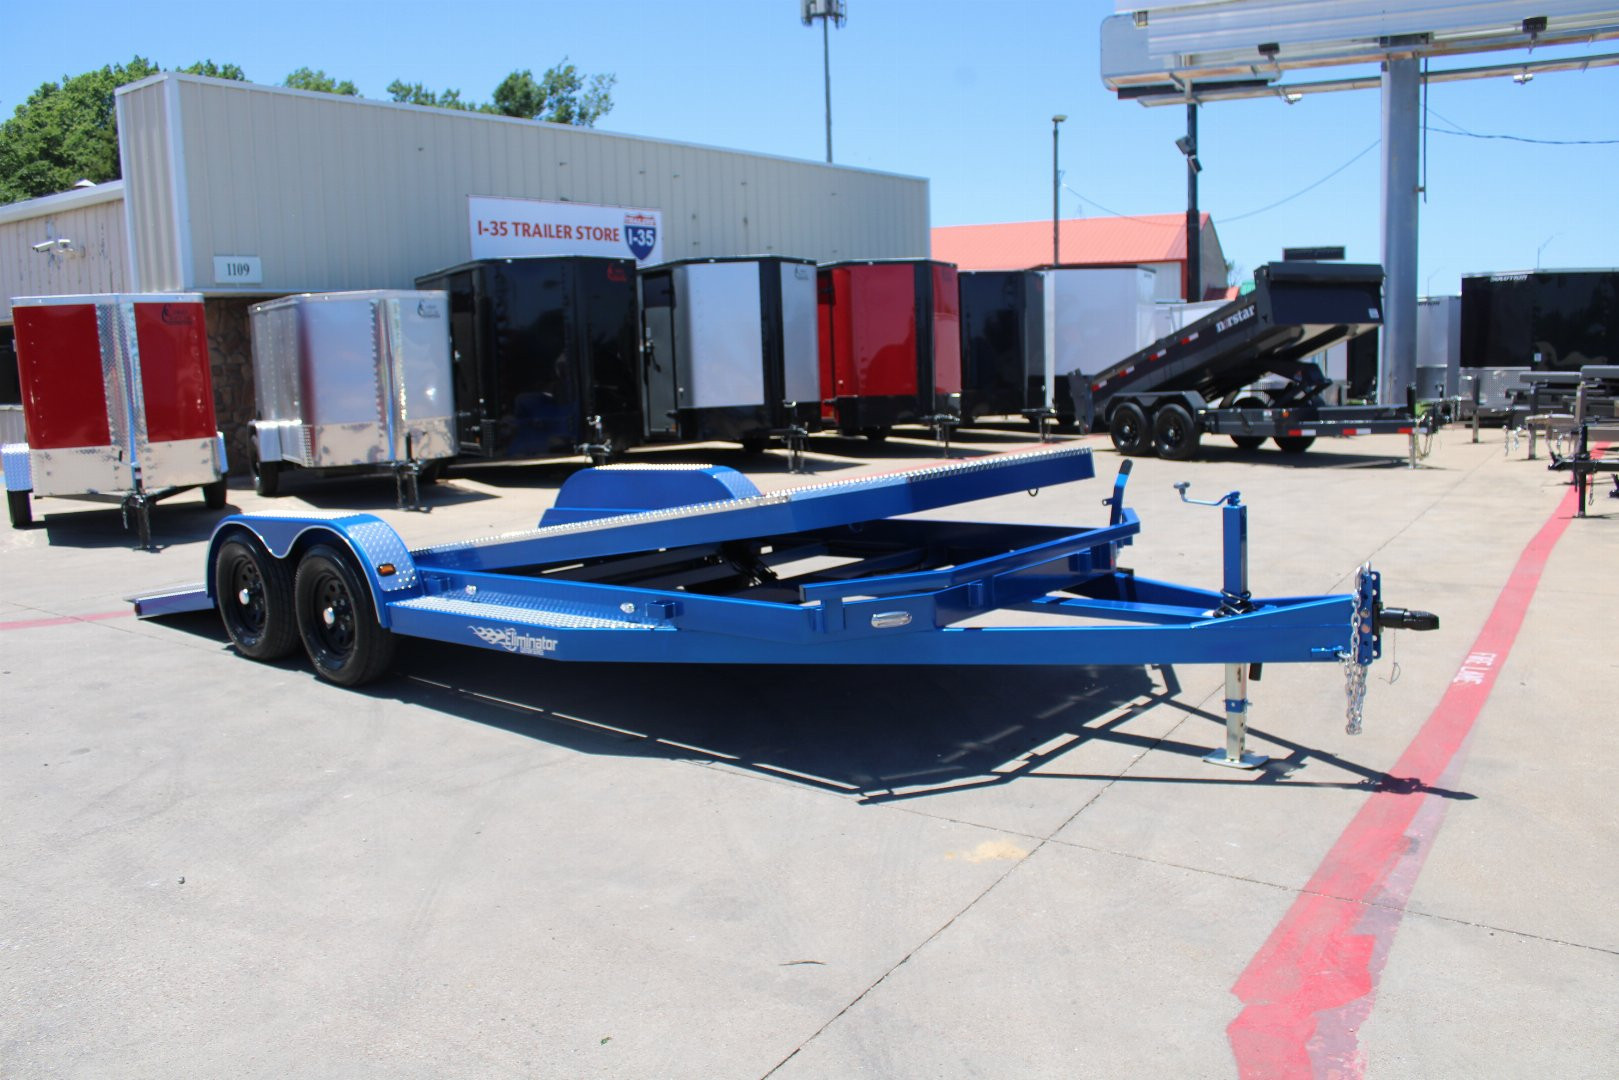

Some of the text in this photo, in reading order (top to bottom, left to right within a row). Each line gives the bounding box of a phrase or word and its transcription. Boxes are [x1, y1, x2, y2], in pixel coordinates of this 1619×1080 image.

[478, 220, 620, 242] I-35 TRAILER STORE
[627, 228, 654, 247] I-35
[227, 263, 250, 276] 1109
